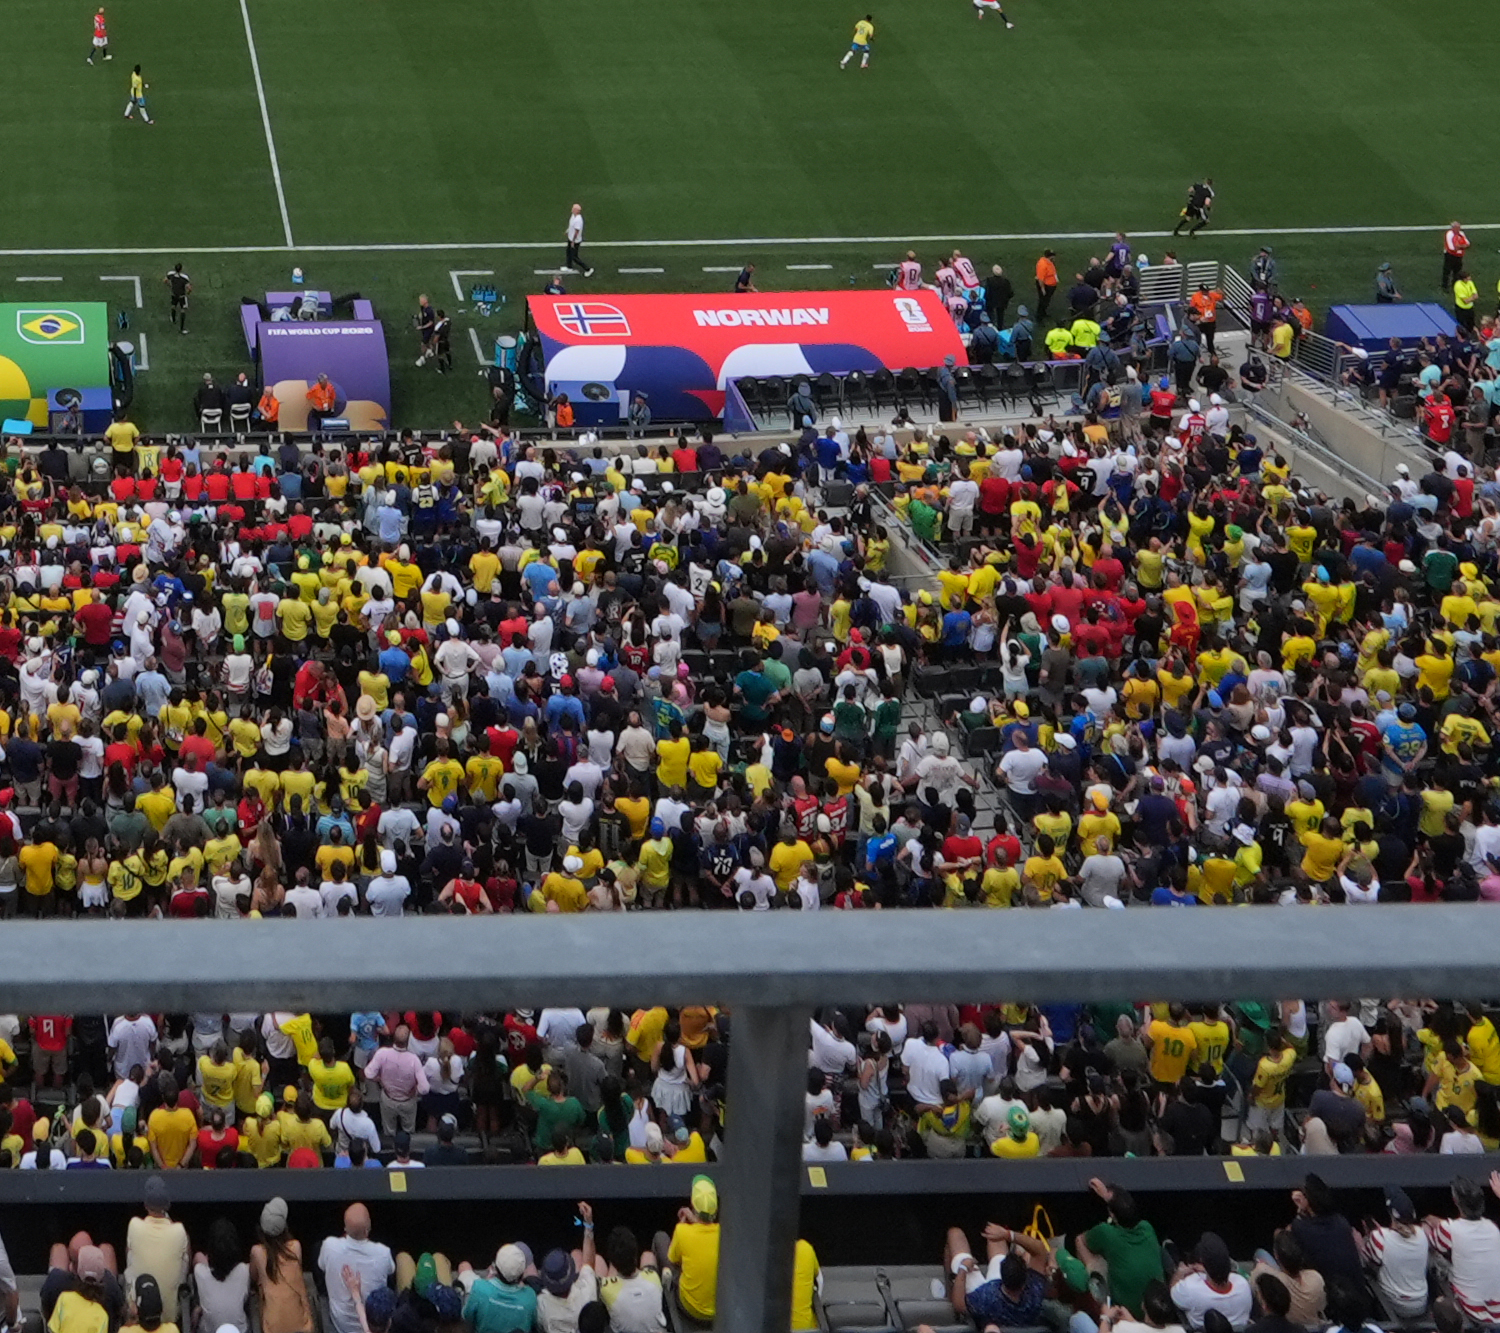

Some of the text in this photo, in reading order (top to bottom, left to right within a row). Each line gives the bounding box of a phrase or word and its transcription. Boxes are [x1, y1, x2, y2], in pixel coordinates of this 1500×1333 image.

[693, 307, 829, 327] NORWAY
[267, 326, 373, 336] FIFA WORLD CUP 2026
[41, 1018, 56, 1037] 9
[1163, 1037, 1185, 1058] 10
